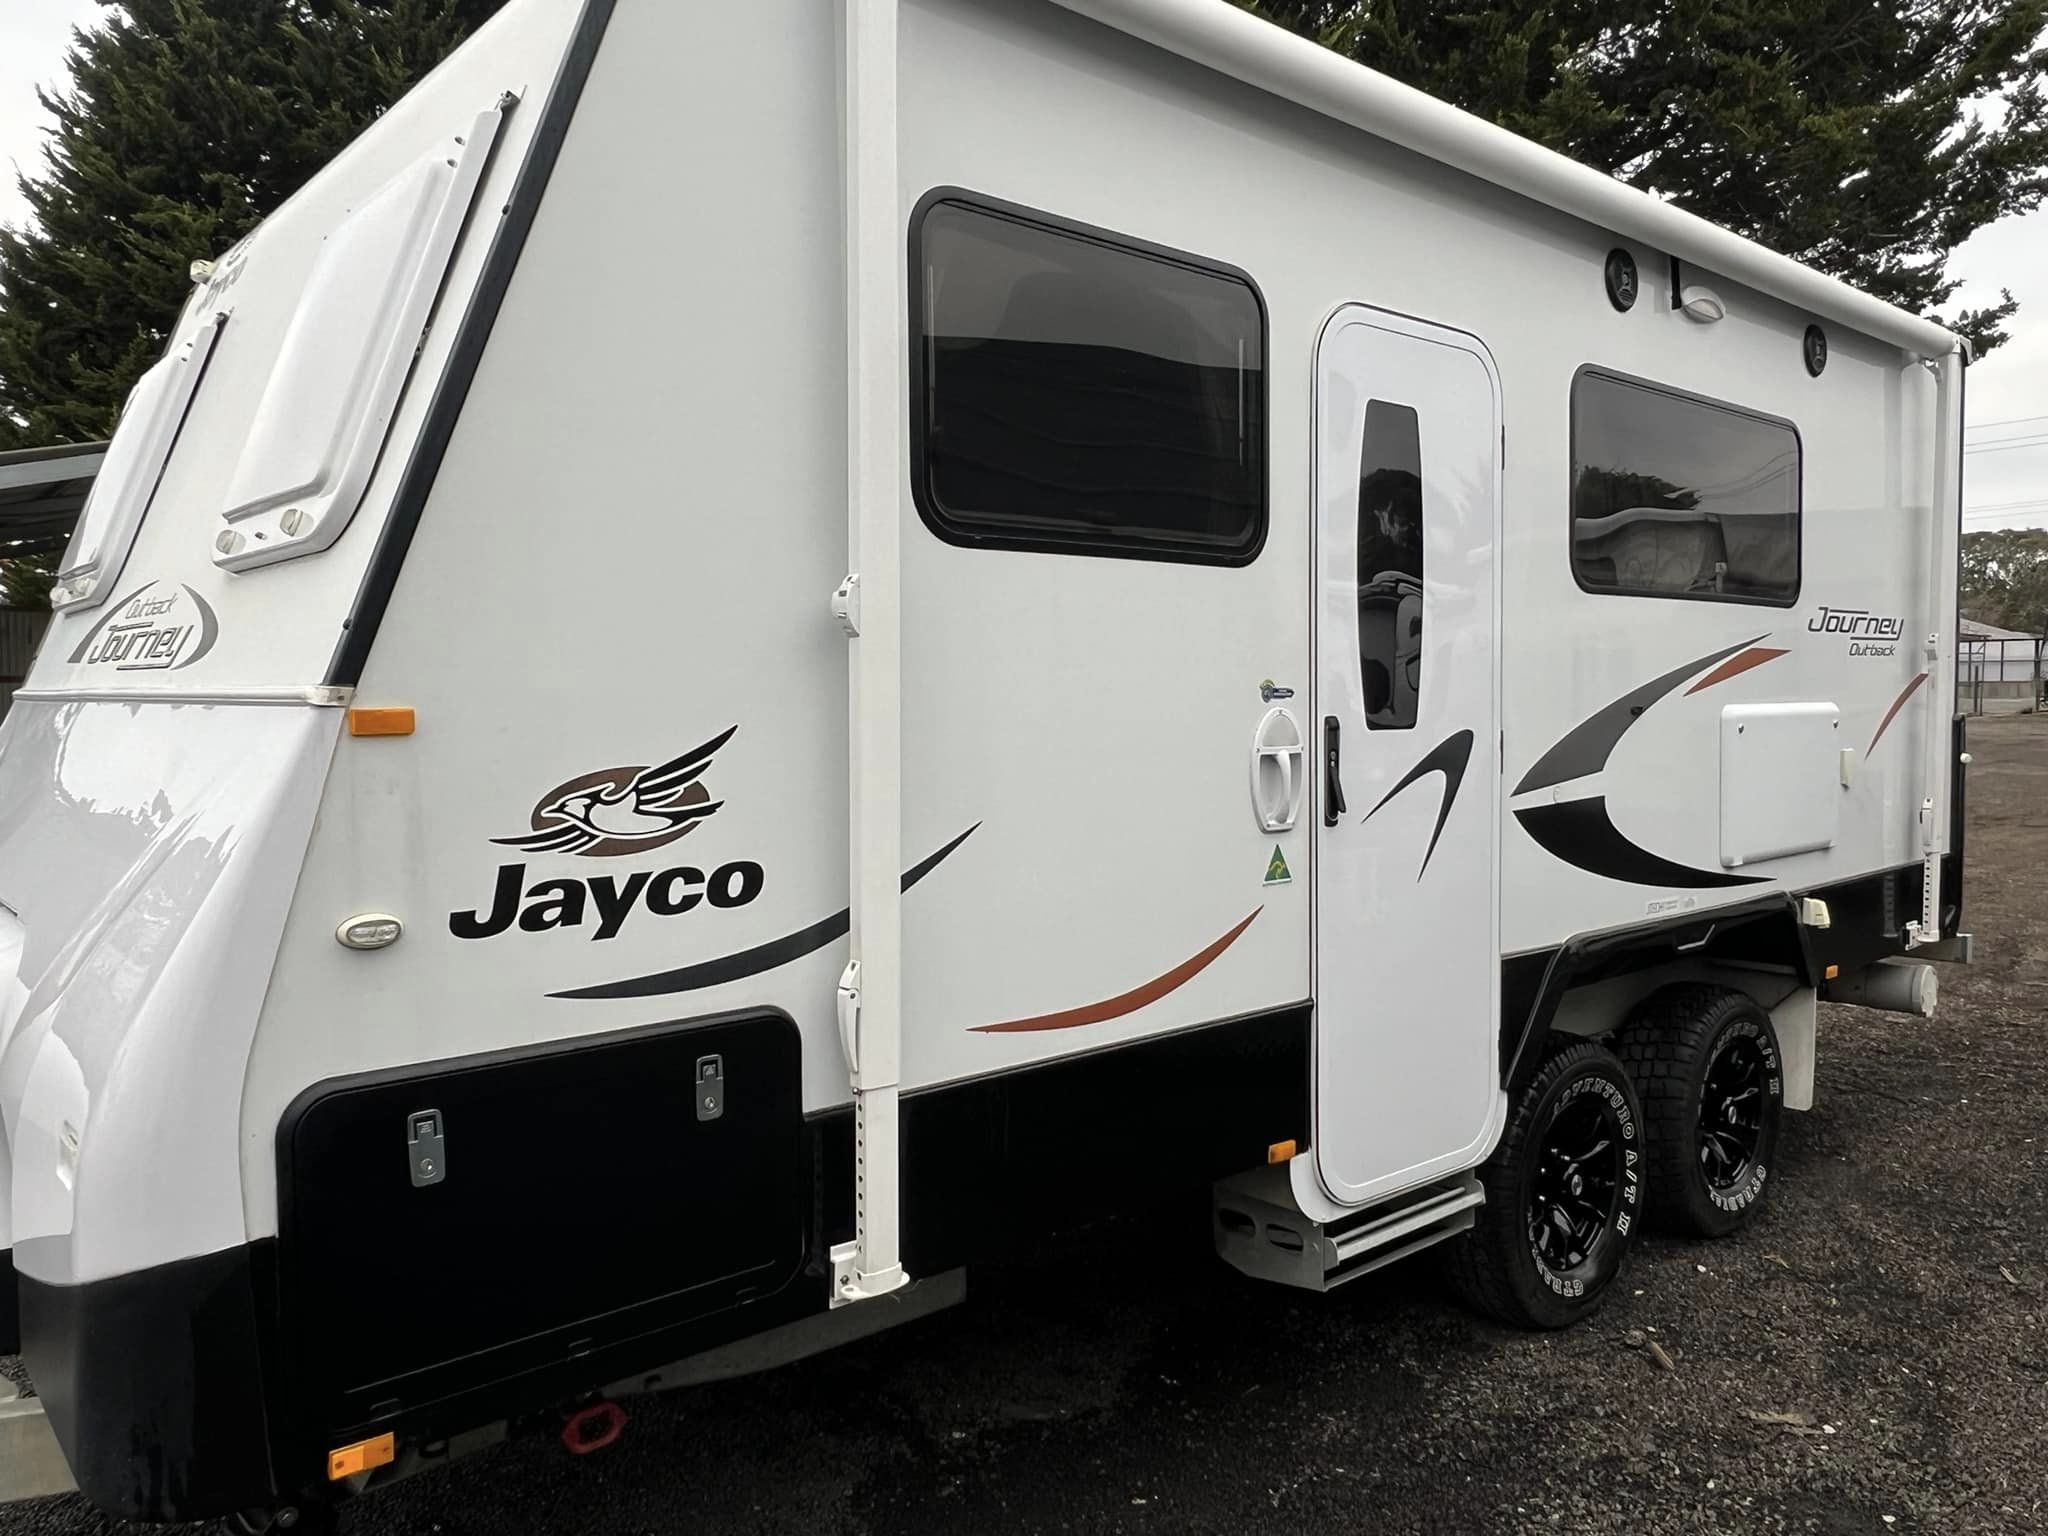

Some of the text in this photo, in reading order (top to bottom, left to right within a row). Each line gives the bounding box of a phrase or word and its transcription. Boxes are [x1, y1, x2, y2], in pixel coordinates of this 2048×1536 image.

[88, 621, 194, 671] Journey
[1808, 606, 1905, 641] Journey
[1848, 642, 1897, 657] Outback
[448, 859, 766, 942] Jayco
[1623, 1148, 1640, 1205] A/T
